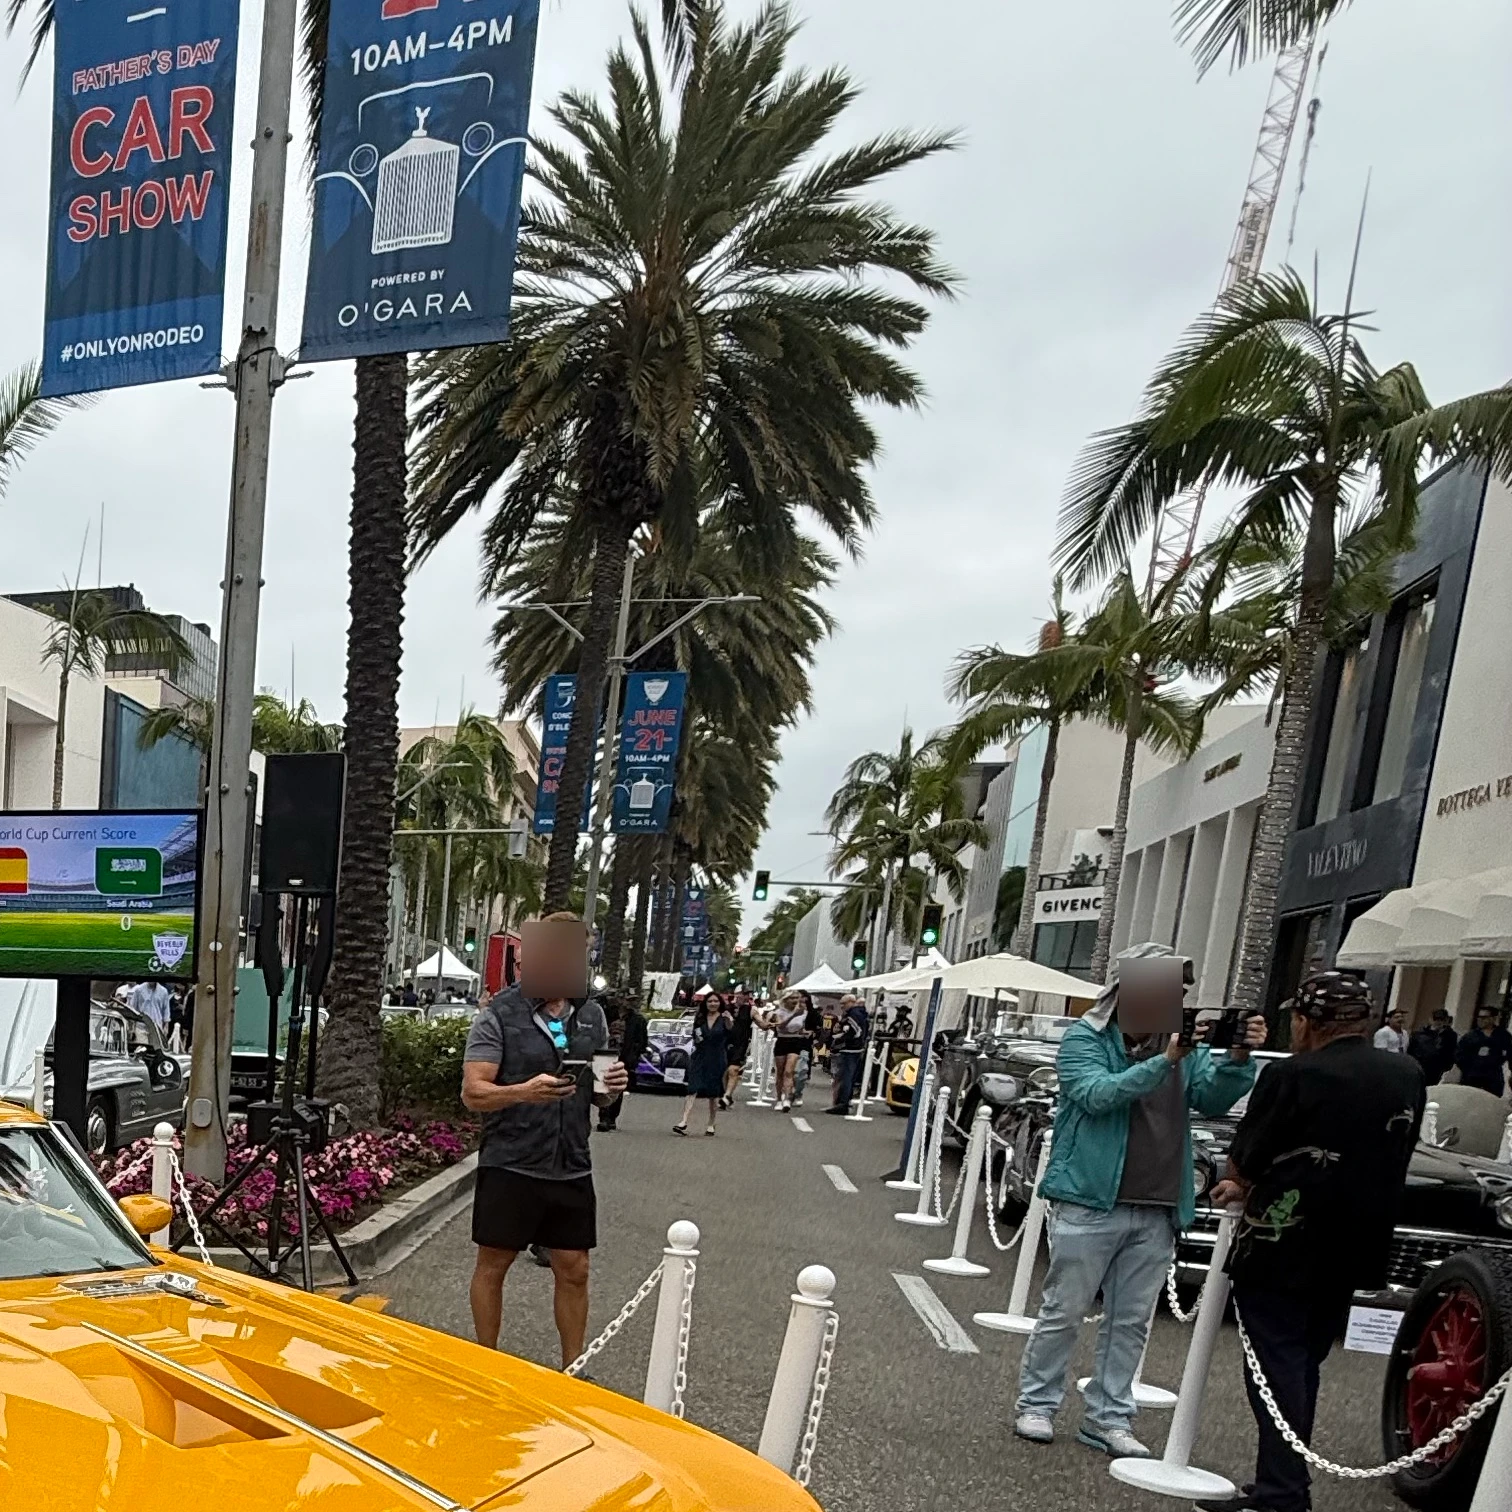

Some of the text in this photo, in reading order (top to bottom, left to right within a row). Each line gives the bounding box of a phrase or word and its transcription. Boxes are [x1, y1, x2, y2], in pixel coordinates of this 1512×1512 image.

[72, 38, 220, 95] FATHER'S DAY
[70, 85, 216, 178] CAR
[67, 169, 215, 243] SHOW
[371, 269, 445, 289] POWERED BY
[338, 290, 472, 328] O'GARA
[60, 324, 204, 363] #ONLYONRODEO
[627, 709, 678, 726] JUNE
[1436, 783, 1491, 816] BOTTEGA
[26, 826, 49, 842] Cup
[52, 827, 97, 841] Current
[101, 827, 137, 840] Score
[106, 899, 154, 909] Saudi Arabia
[1042, 897, 1103, 913] GIVENC
[120, 914, 133, 931] 0
[157, 940, 184, 949] BEVERLY
